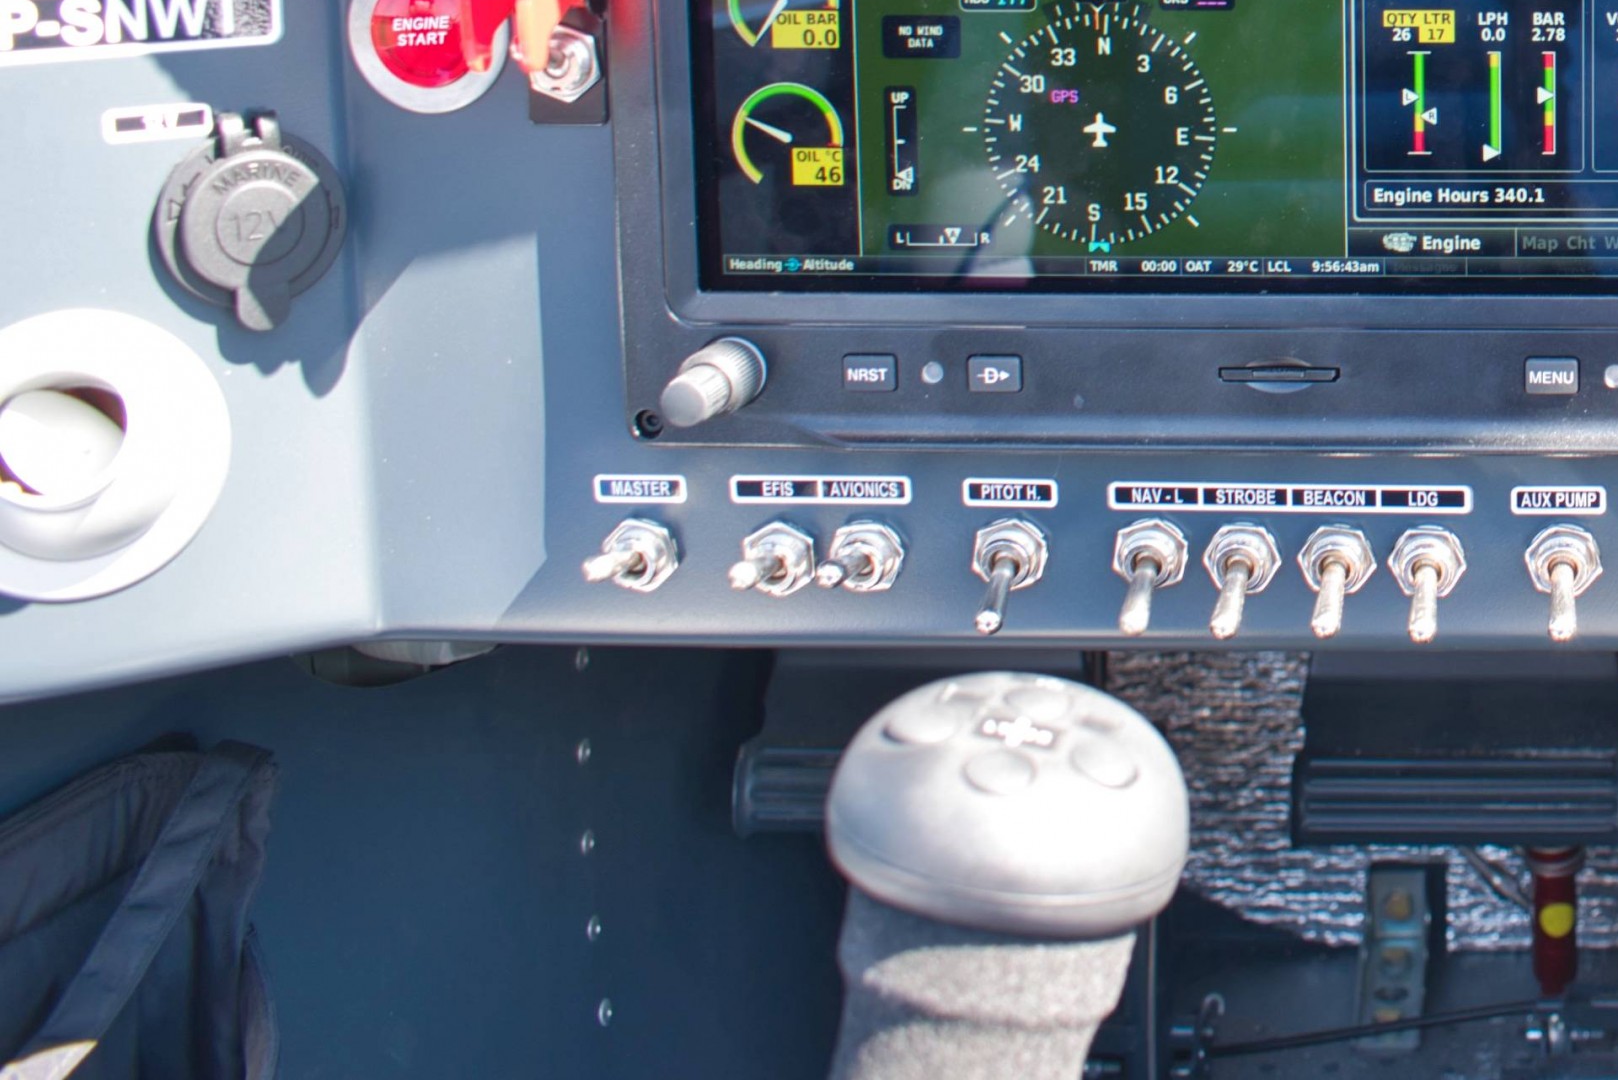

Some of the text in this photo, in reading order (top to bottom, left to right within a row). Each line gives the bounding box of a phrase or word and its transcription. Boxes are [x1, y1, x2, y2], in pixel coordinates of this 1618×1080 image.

[391, 15, 450, 32] ENGINE
[397, 31, 448, 47] START
[1050, 48, 1076, 67] 33
[814, 166, 842, 184] 46
[1373, 187, 1545, 206] Engine Hours 340.1
[1422, 235, 1481, 253] Engine
[729, 258, 783, 273] Heading
[802, 258, 854, 272] Altitude
[1089, 260, 1178, 273] TMR 00:00
[1267, 260, 1292, 273] LCL
[1311, 260, 1380, 273] 9:56:43am
[847, 368, 888, 383] NRST
[1528, 370, 1575, 385] MENU
[610, 481, 671, 497] MASTER
[762, 481, 794, 497] EFIS
[830, 481, 899, 498] AVIONICS
[981, 483, 1042, 501] PITOT H.
[1215, 489, 1277, 505] STROBE
[1303, 490, 1366, 506] BEACON
[1408, 491, 1439, 507] LDG
[1521, 492, 1597, 508] AUX PUMP
